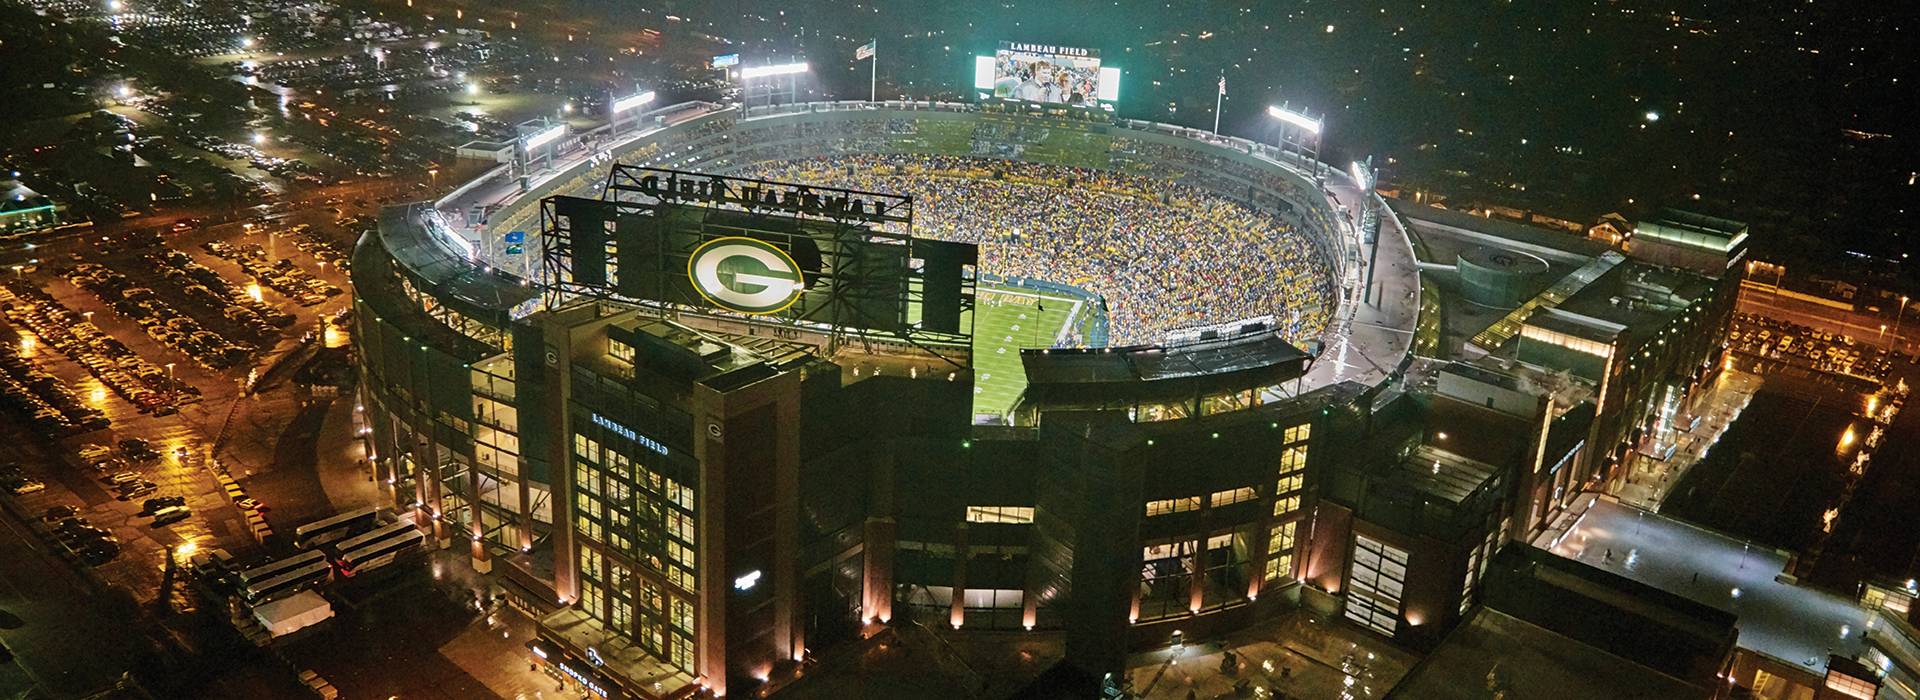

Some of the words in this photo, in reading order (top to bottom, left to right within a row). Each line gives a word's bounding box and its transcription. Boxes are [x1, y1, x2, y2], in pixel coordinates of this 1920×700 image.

[1010, 42, 1056, 54] LAMBEAU
[1059, 46, 1088, 56] FIELD
[695, 244, 797, 308] G
[592, 413, 636, 441] LAMBEAU
[639, 435, 668, 456] FIELD
[708, 423, 722, 437] G
